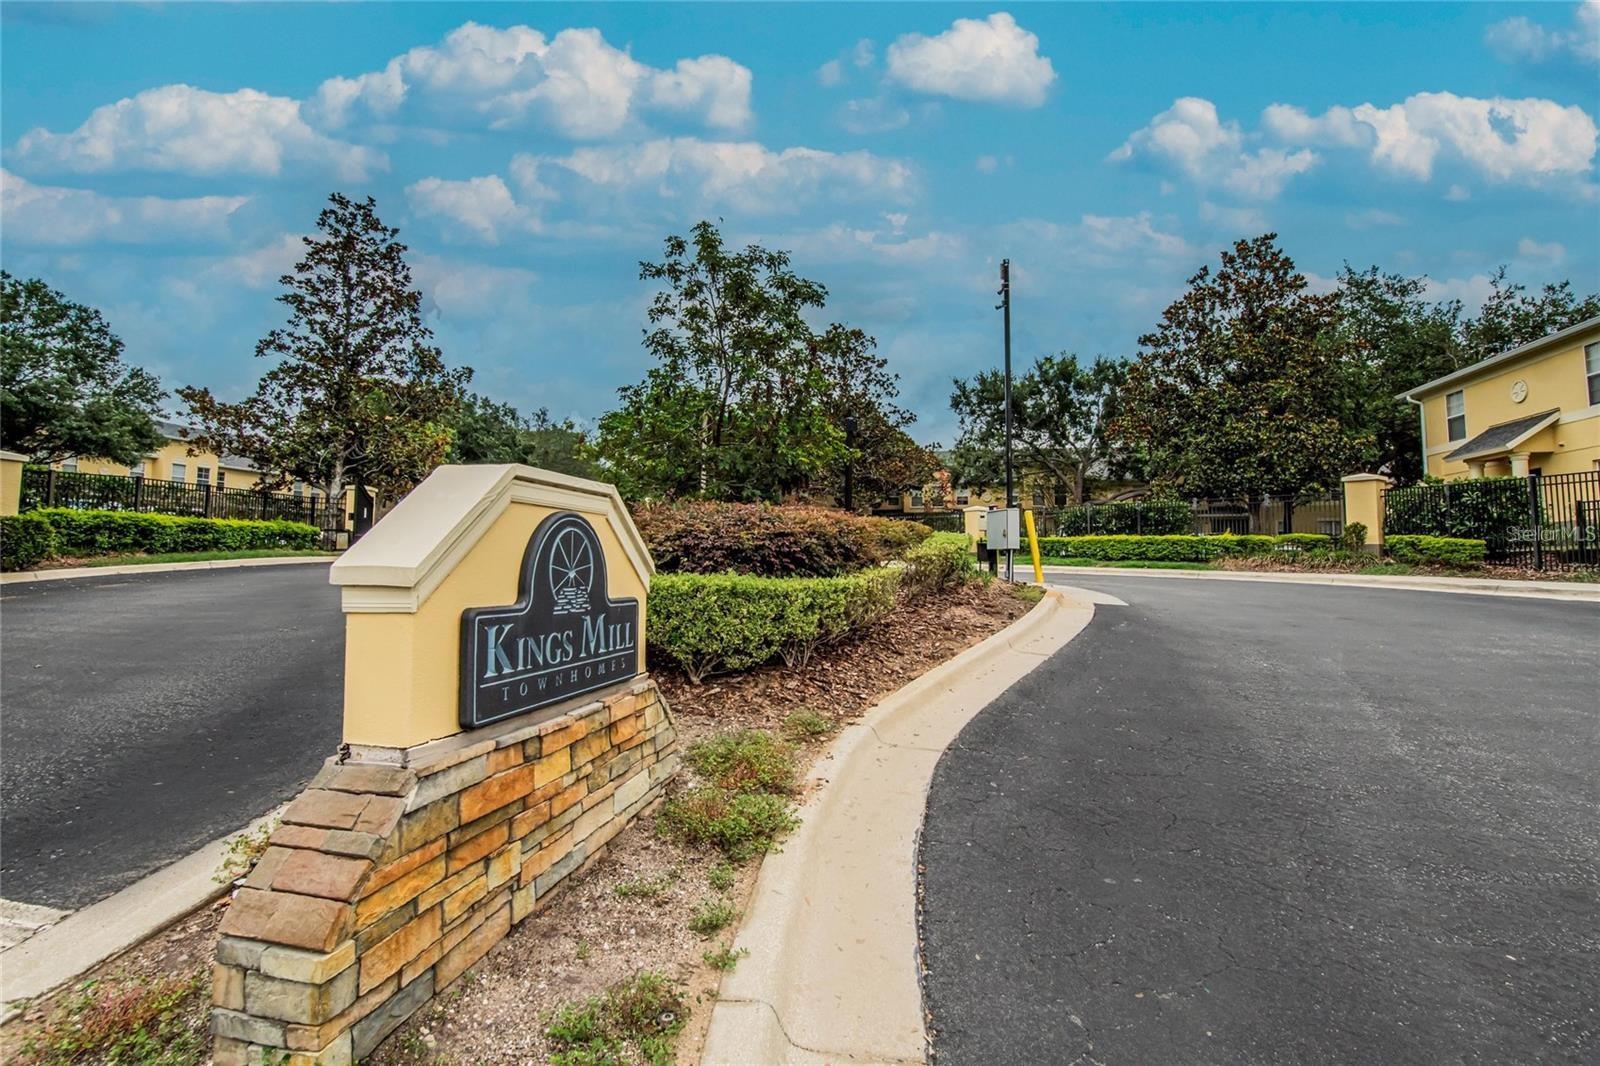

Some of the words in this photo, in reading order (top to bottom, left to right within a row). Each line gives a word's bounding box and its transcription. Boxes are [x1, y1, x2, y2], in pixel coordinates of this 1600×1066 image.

[484, 623, 573, 678] KINGS
[580, 613, 634, 658] MILL
[502, 660, 626, 701] TOWNHOMES
